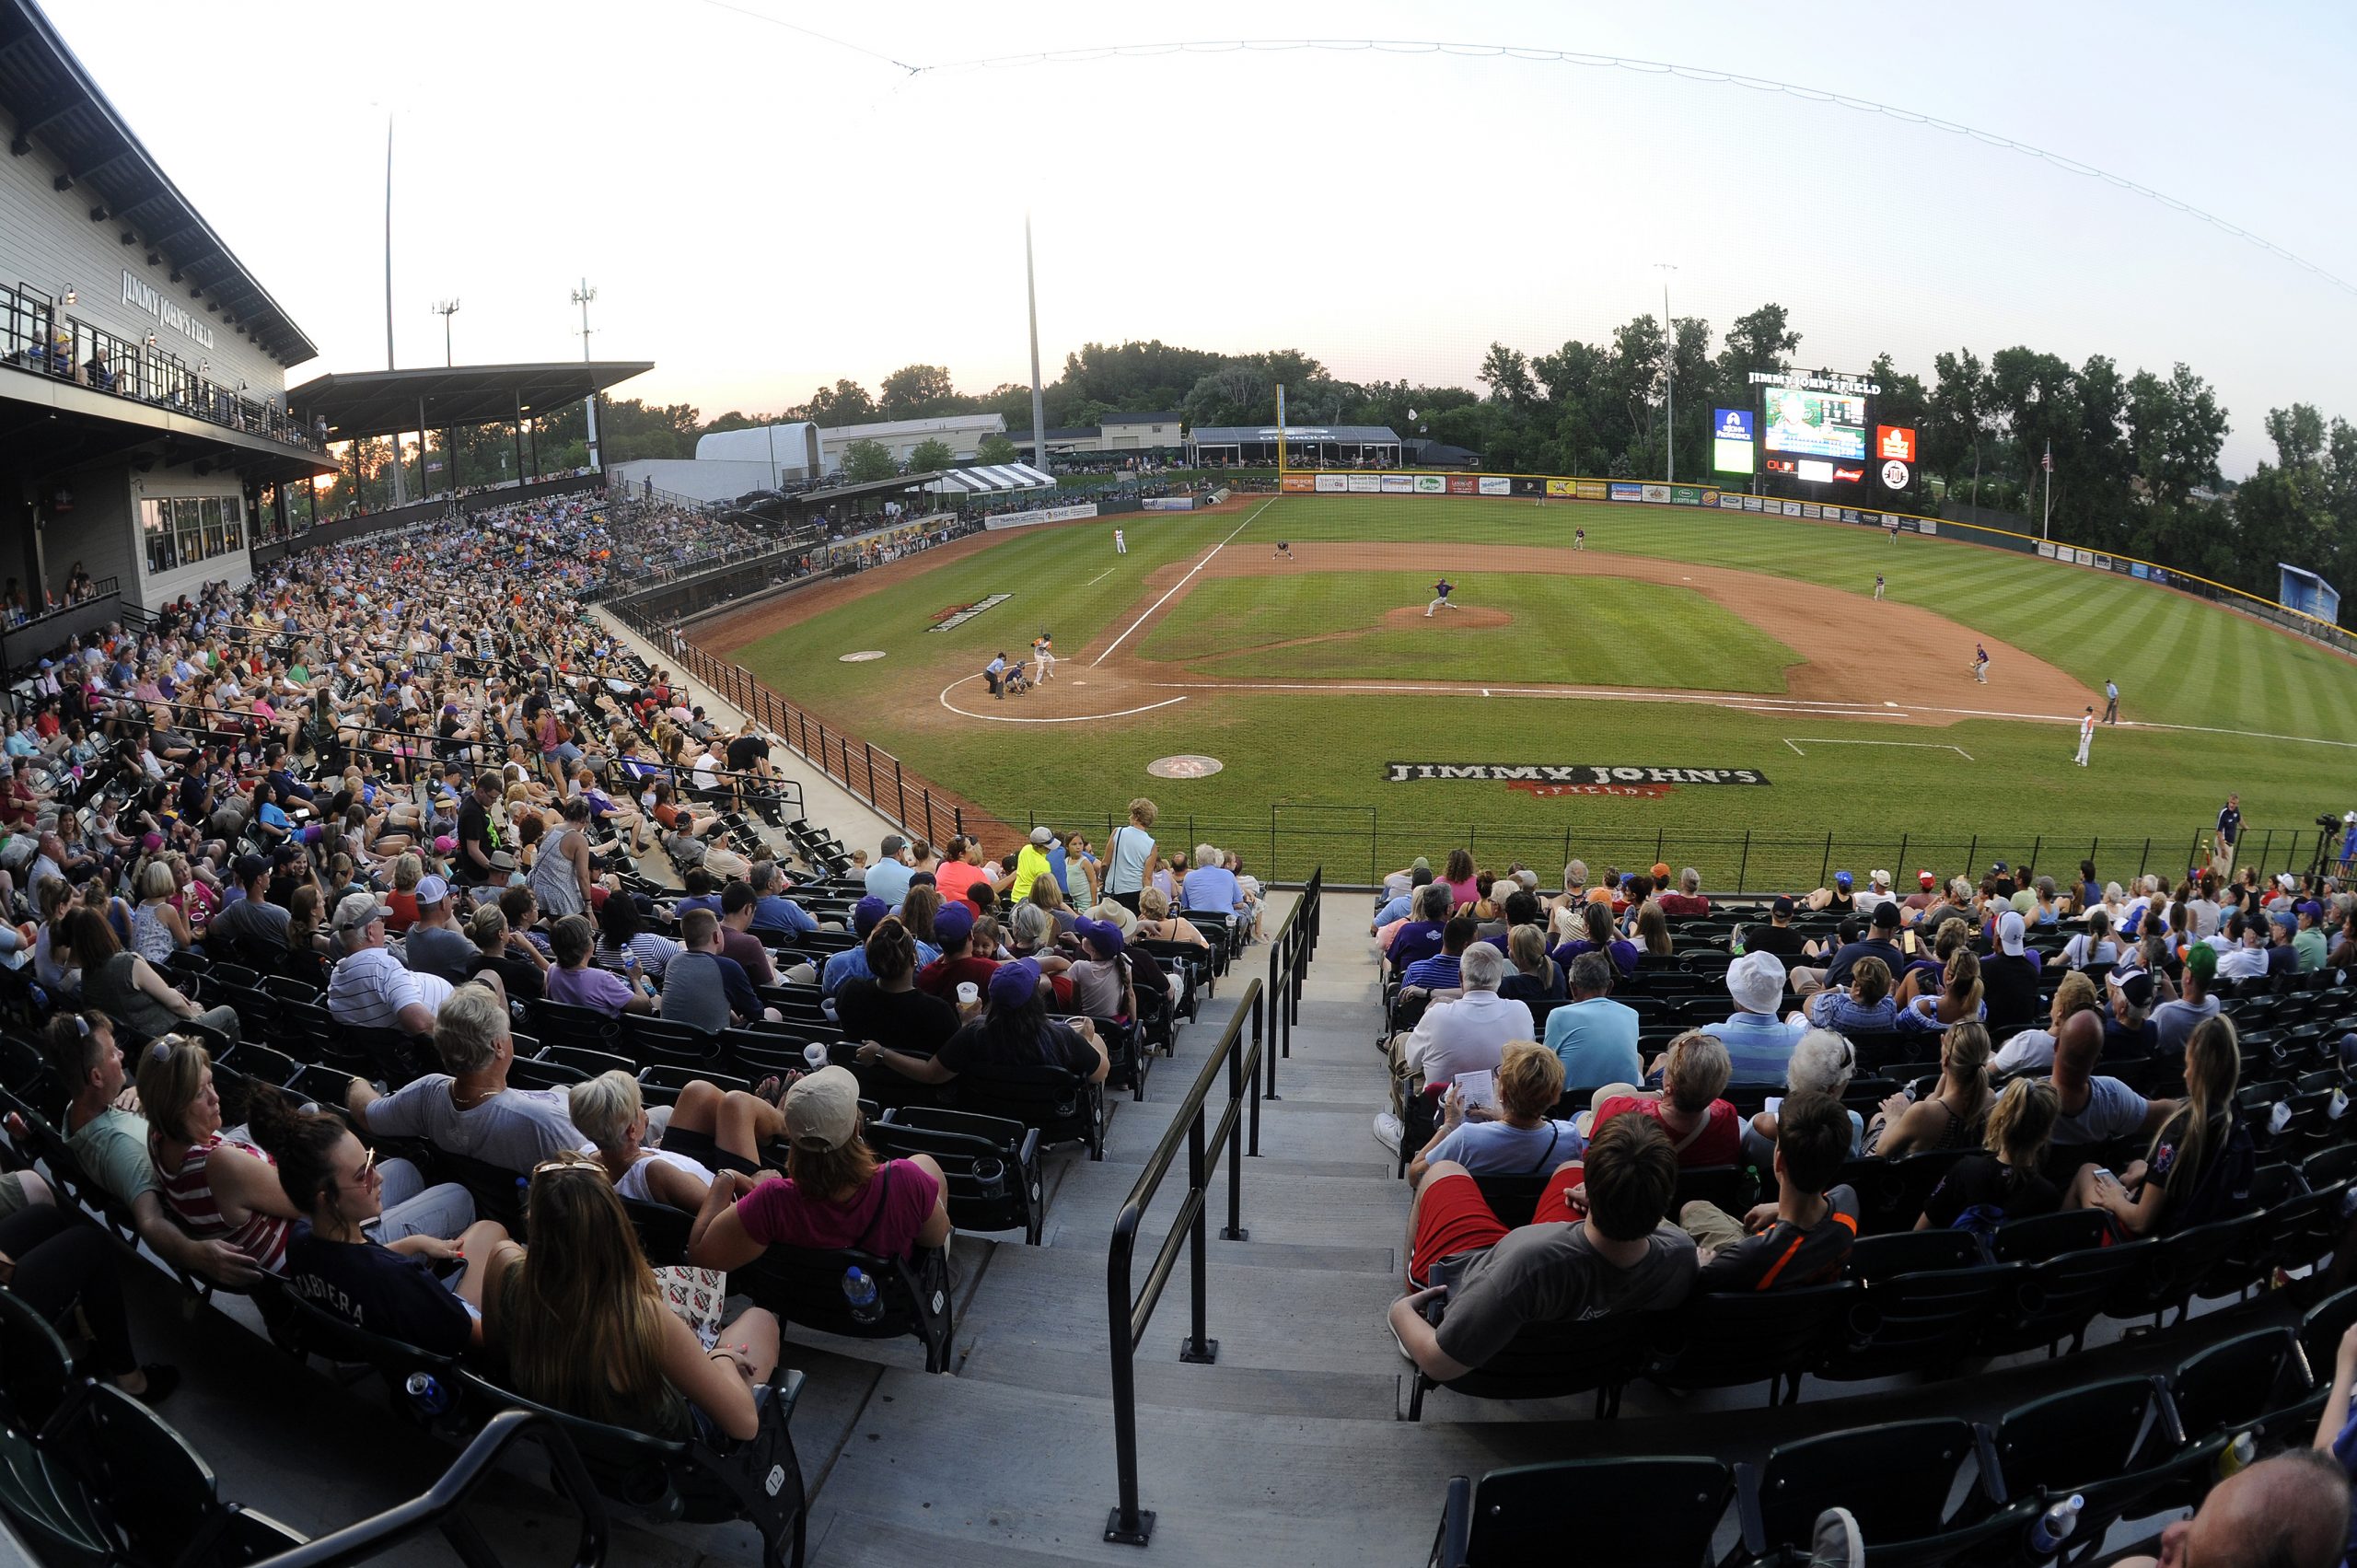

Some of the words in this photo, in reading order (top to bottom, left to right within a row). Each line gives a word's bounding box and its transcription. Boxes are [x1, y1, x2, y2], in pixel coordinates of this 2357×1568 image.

[122, 269, 159, 316] JIMMY
[158, 295, 192, 337] JOHN'S
[191, 317, 214, 350] FIELD
[1748, 371, 1793, 386] JIMMY
[1794, 376, 1840, 391] JOHN'S
[1840, 380, 1882, 395] FIELD
[1388, 763, 1573, 782] JIMMY
[1590, 765, 1759, 785] JOHN'S
[1551, 785, 1637, 796] FIELD
[769, 1470, 783, 1490] 12
